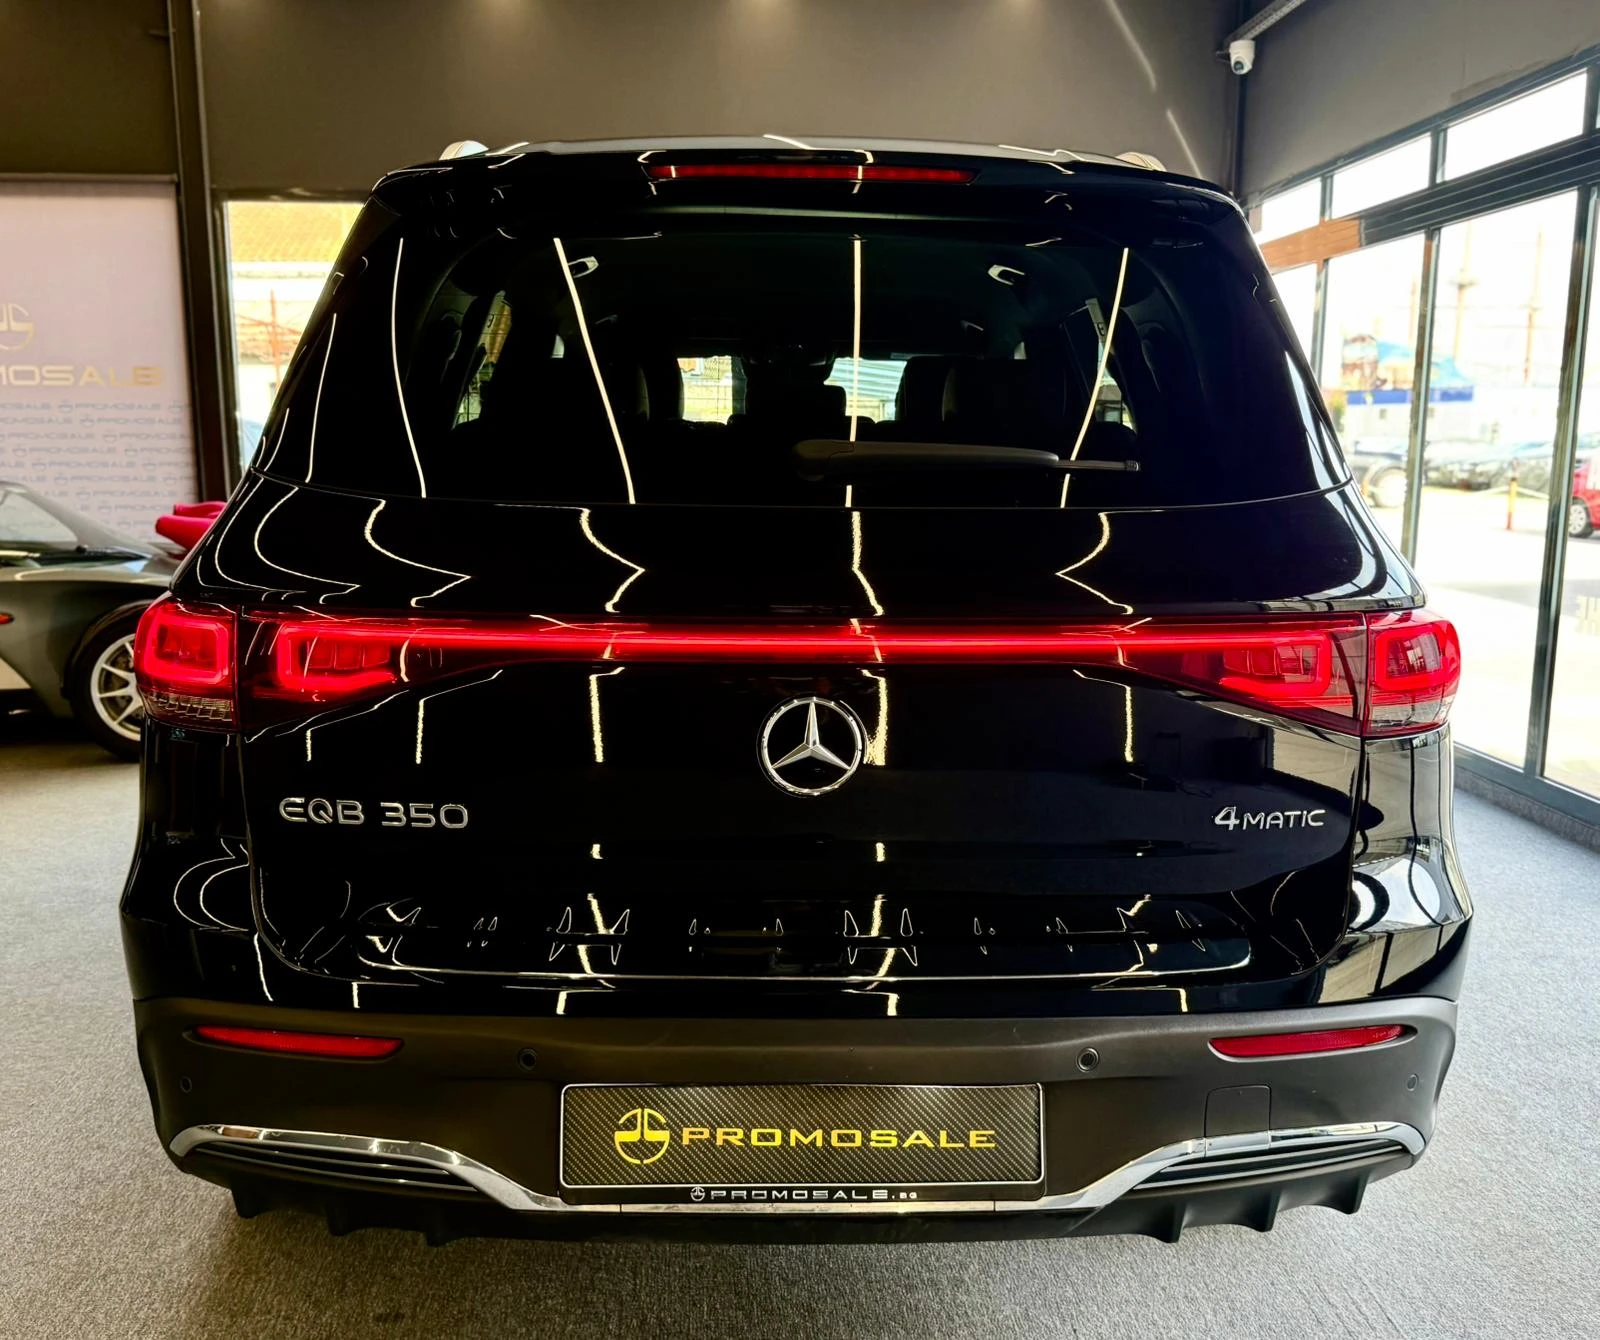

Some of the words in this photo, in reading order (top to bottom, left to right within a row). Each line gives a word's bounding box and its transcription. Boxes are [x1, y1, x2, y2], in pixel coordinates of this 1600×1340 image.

[0, 365, 162, 388] OSALE
[279, 797, 364, 824] EQB
[380, 802, 468, 828] 350
[1214, 806, 1326, 830] 4MATIC
[681, 1127, 996, 1149] PROMOSALE
